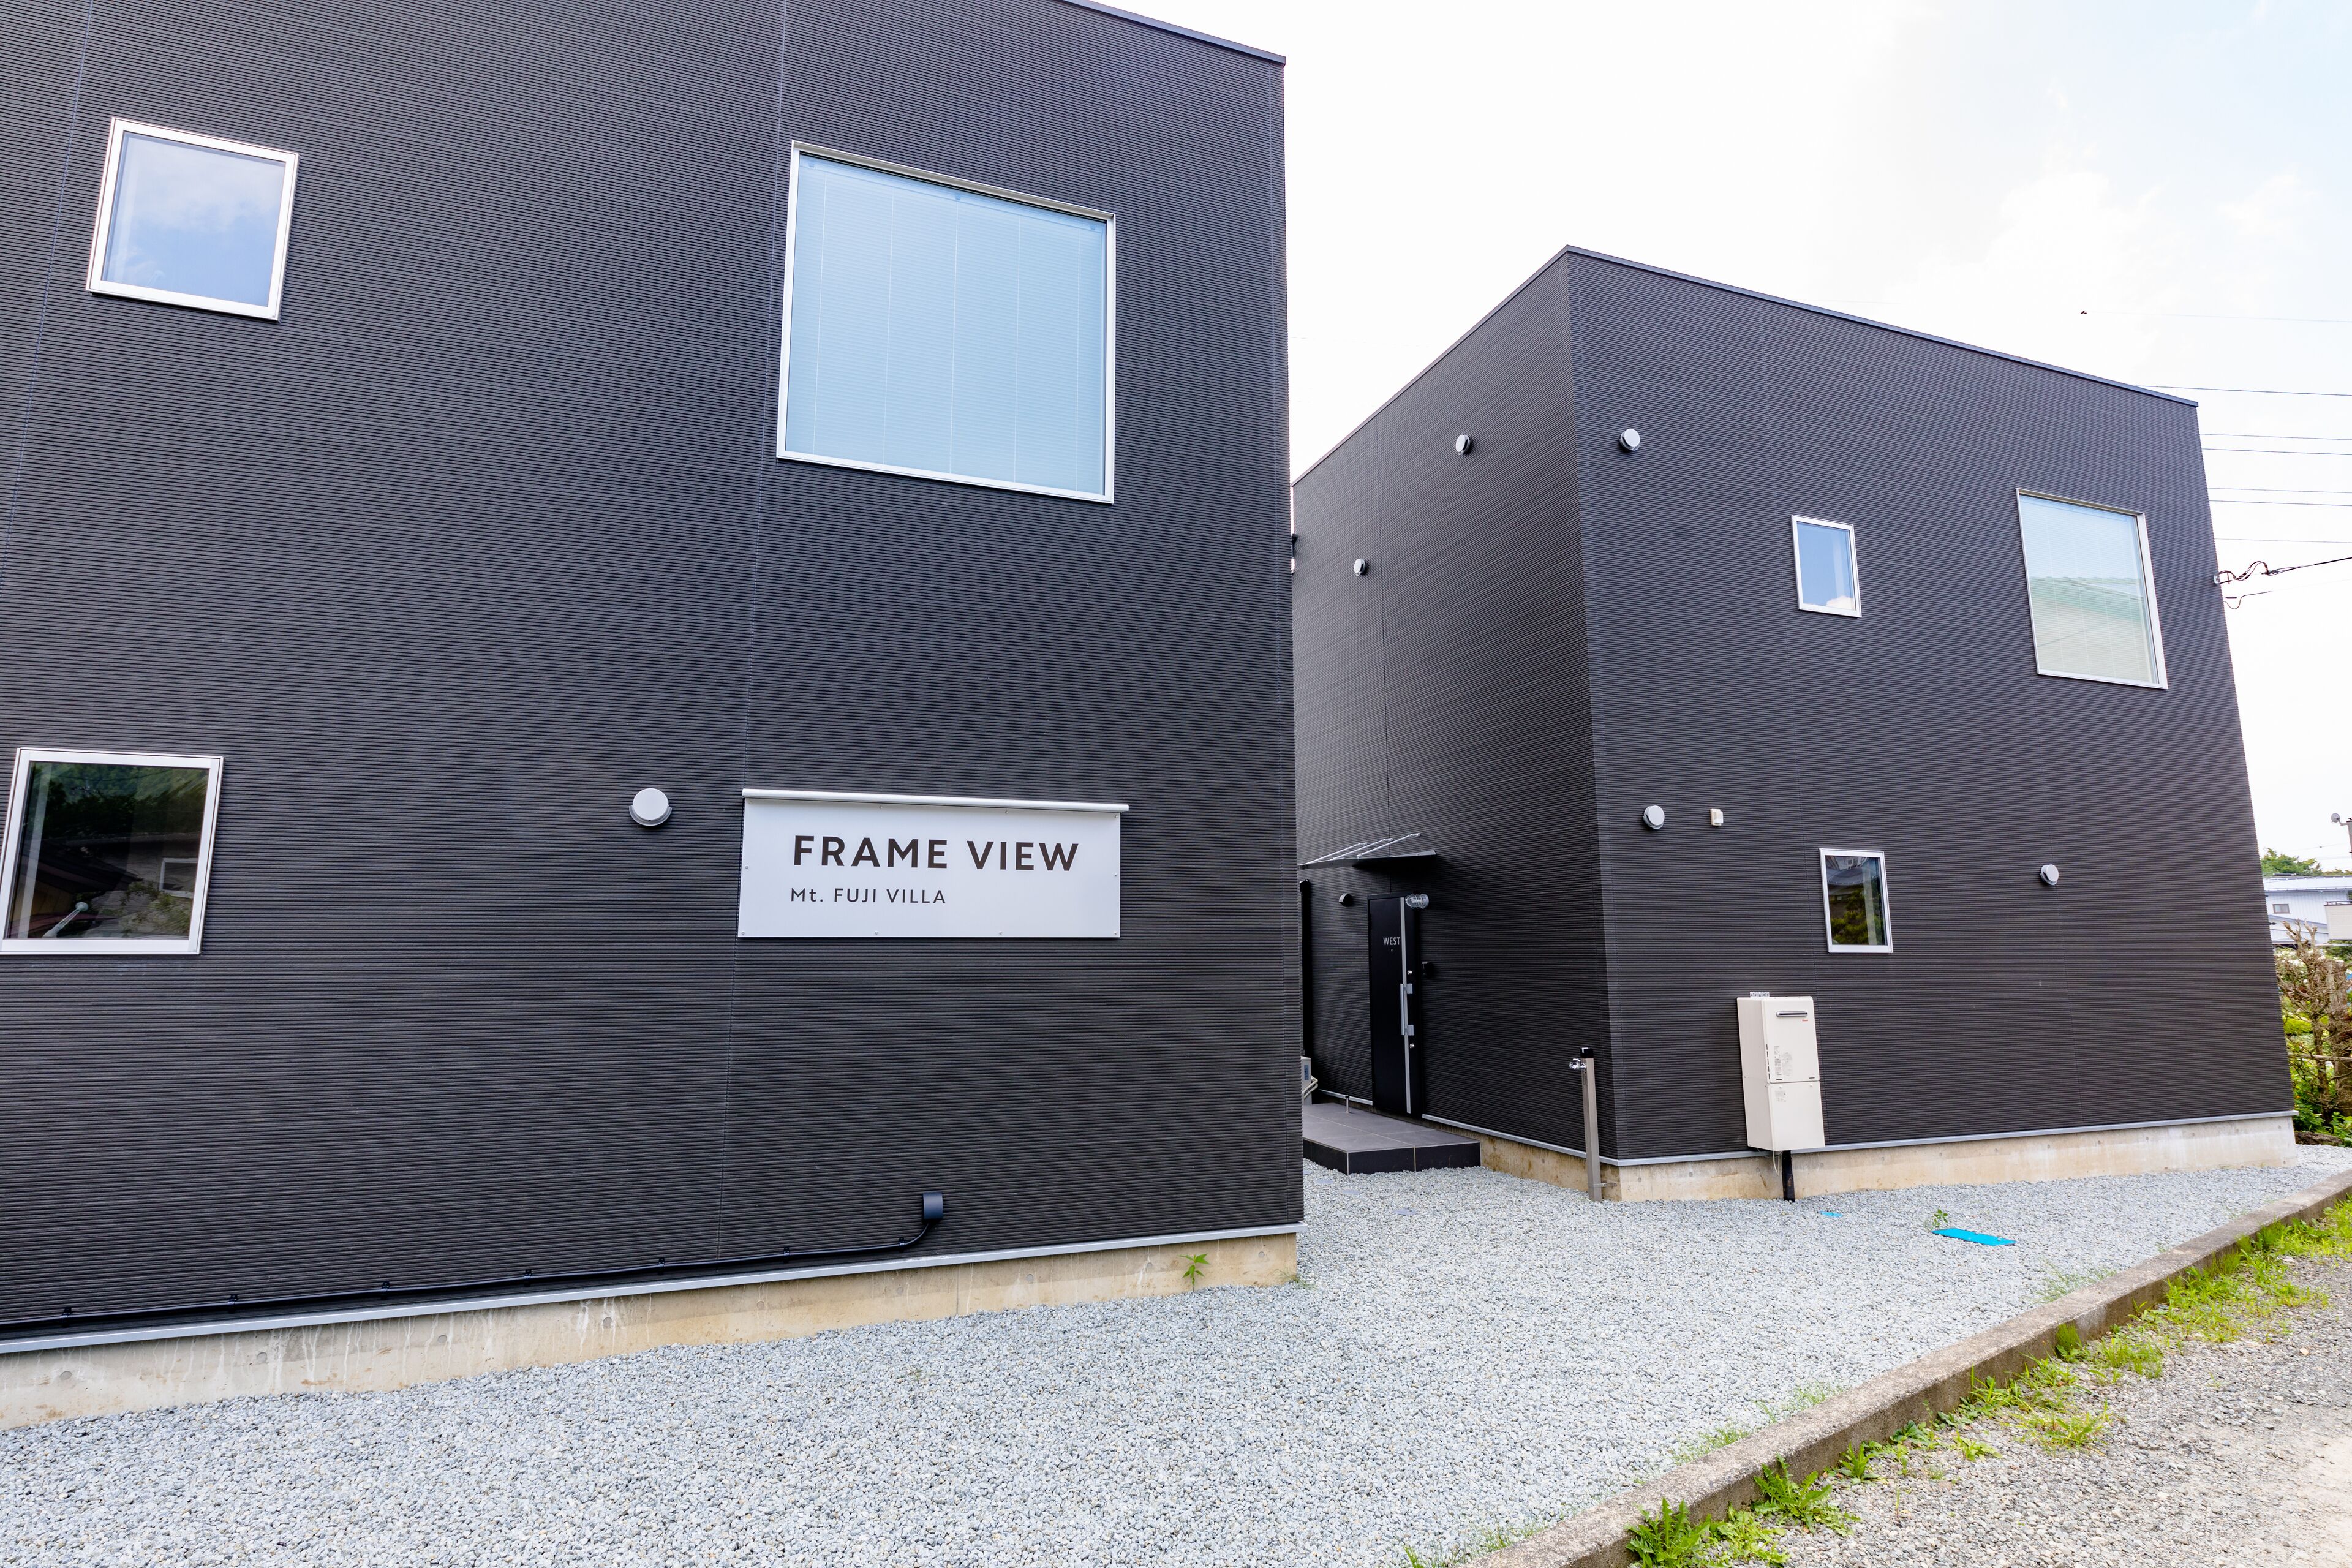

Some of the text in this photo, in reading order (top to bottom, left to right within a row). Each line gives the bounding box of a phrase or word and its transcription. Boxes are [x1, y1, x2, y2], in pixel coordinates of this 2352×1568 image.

[794, 835, 1079, 872] FRAME VIEW
[791, 888, 946, 904] Mt. FUJI VILLA
[1383, 937, 1401, 946] WEST
